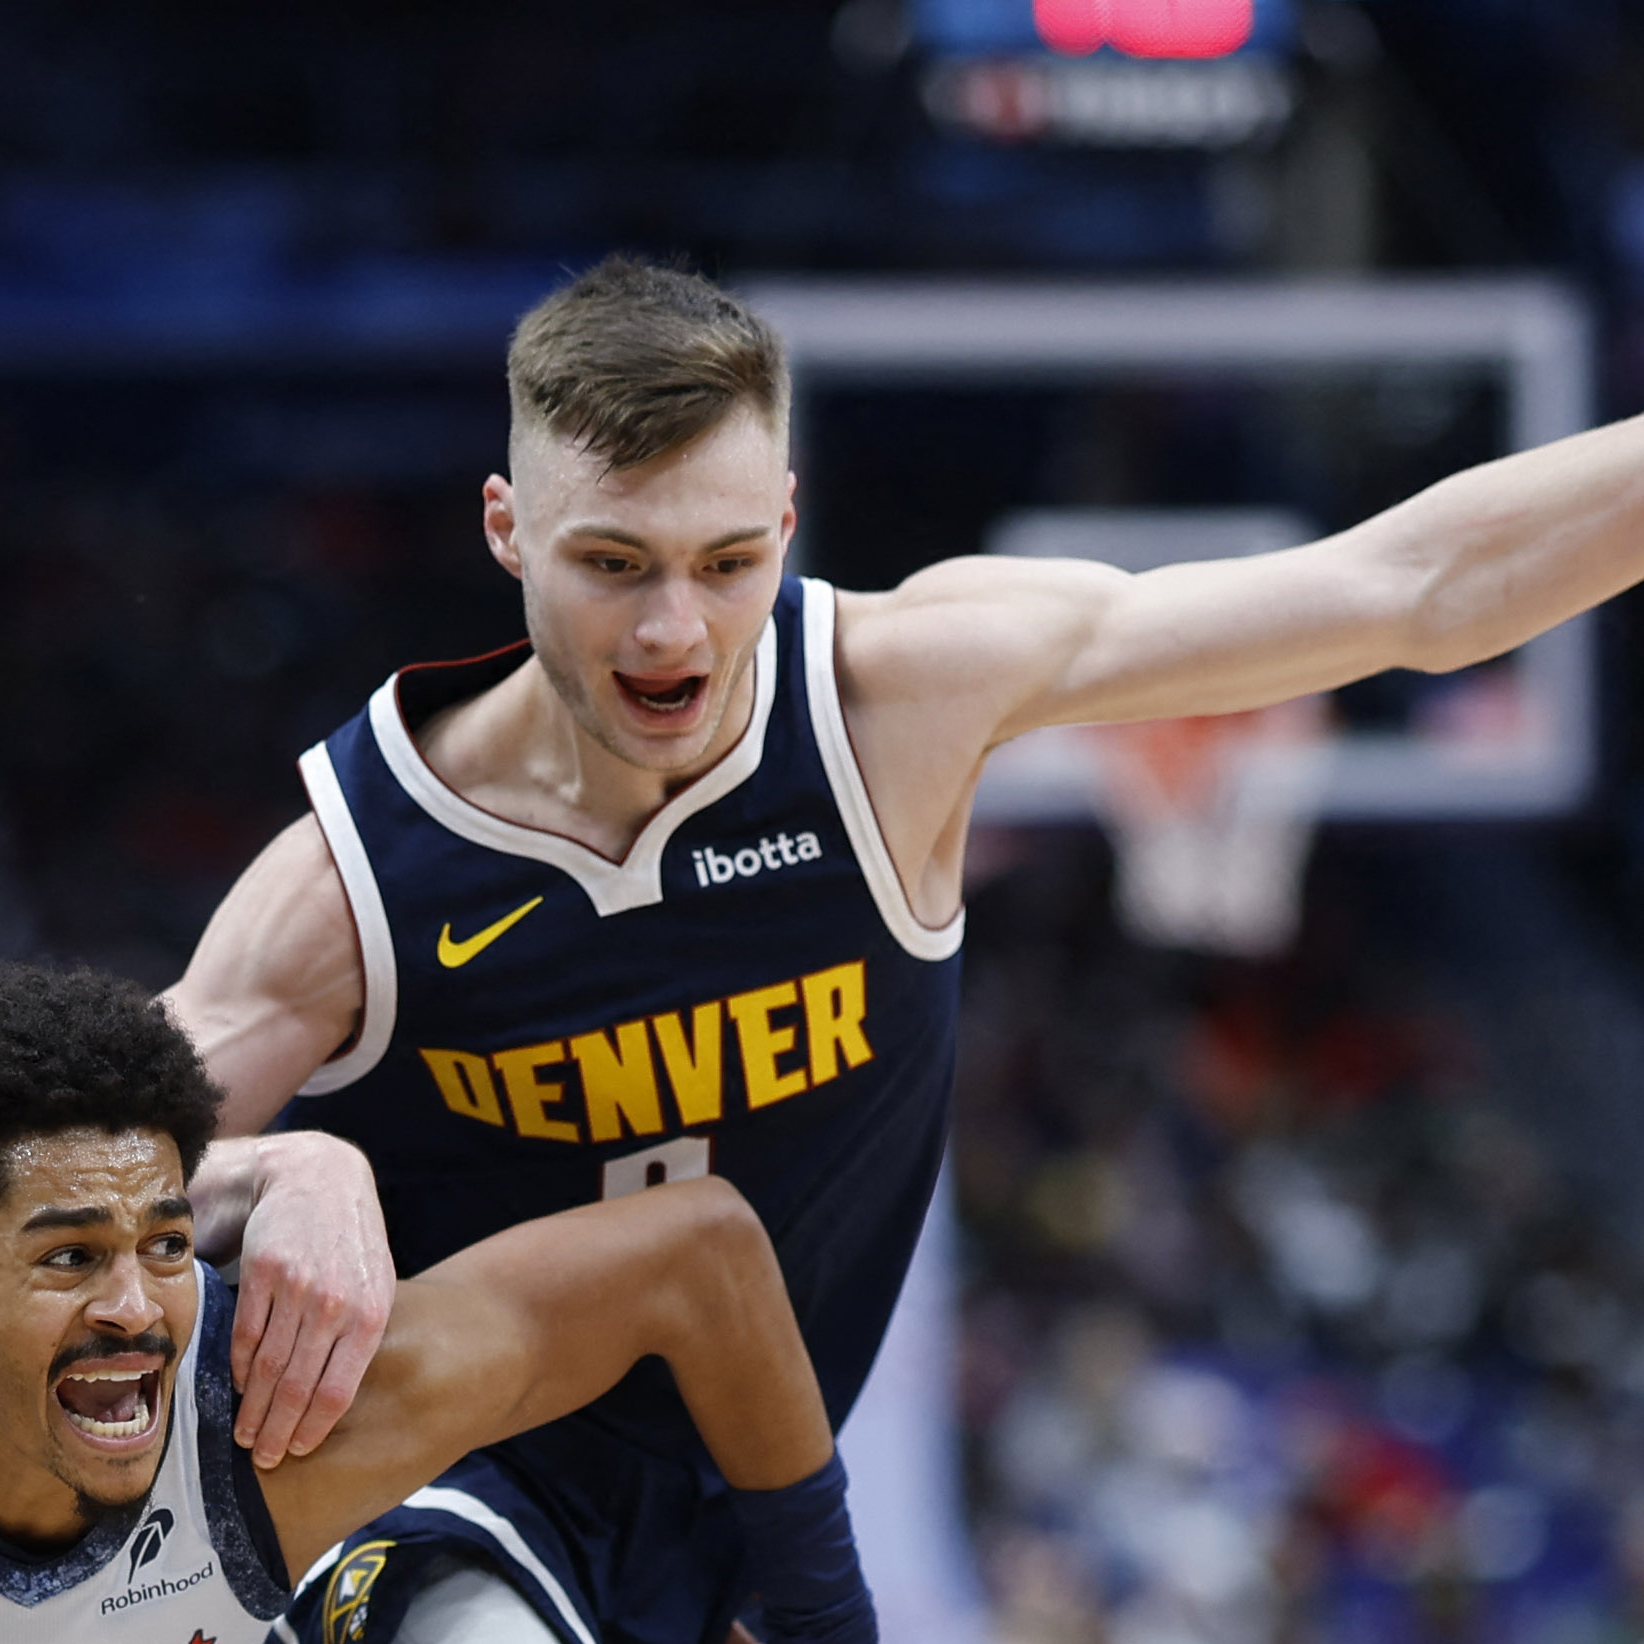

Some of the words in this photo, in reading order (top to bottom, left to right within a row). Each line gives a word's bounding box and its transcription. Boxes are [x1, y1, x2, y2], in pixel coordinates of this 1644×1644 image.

[692, 831, 823, 888] ibotta
[417, 958, 876, 1144] DENVER
[101, 1562, 214, 1616] Robinhood
